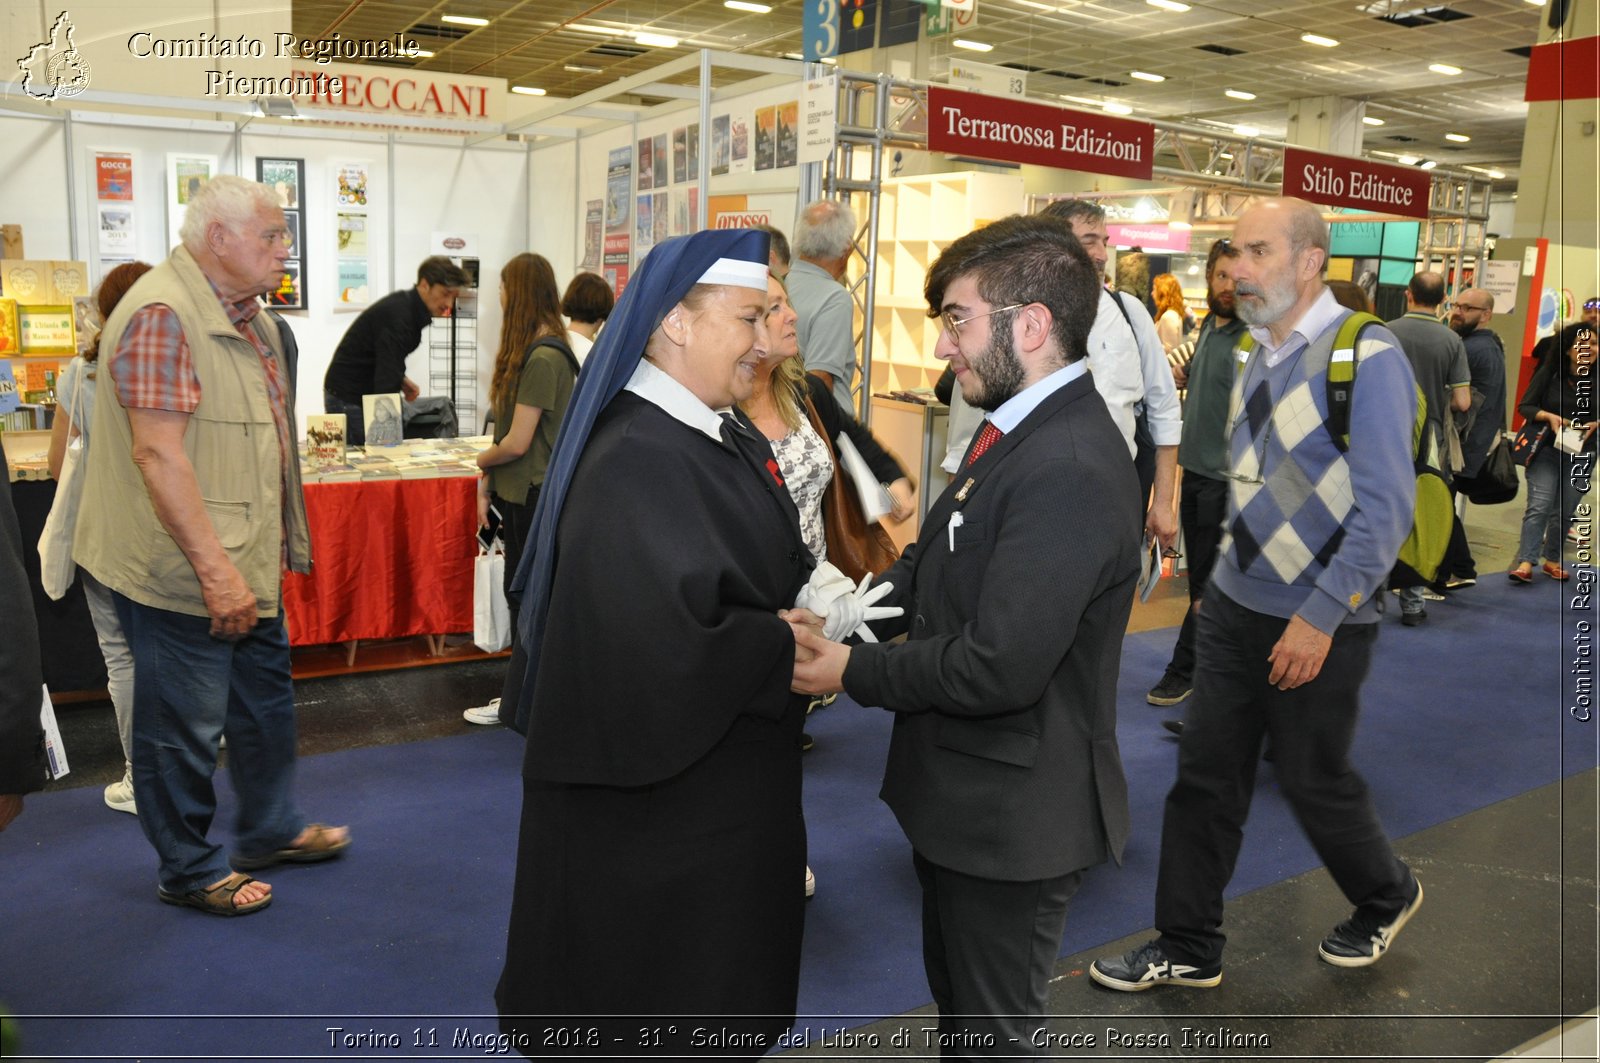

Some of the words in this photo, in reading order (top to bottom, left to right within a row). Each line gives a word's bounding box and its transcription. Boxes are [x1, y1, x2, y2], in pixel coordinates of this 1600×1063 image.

[815, 0, 837, 56] 3
[290, 69, 489, 117] TRECCANI
[942, 106, 1055, 149] Terrarossa
[1060, 124, 1143, 162] Edizioni
[1302, 164, 1344, 196] Stilo
[1348, 171, 1413, 206] Editrice
